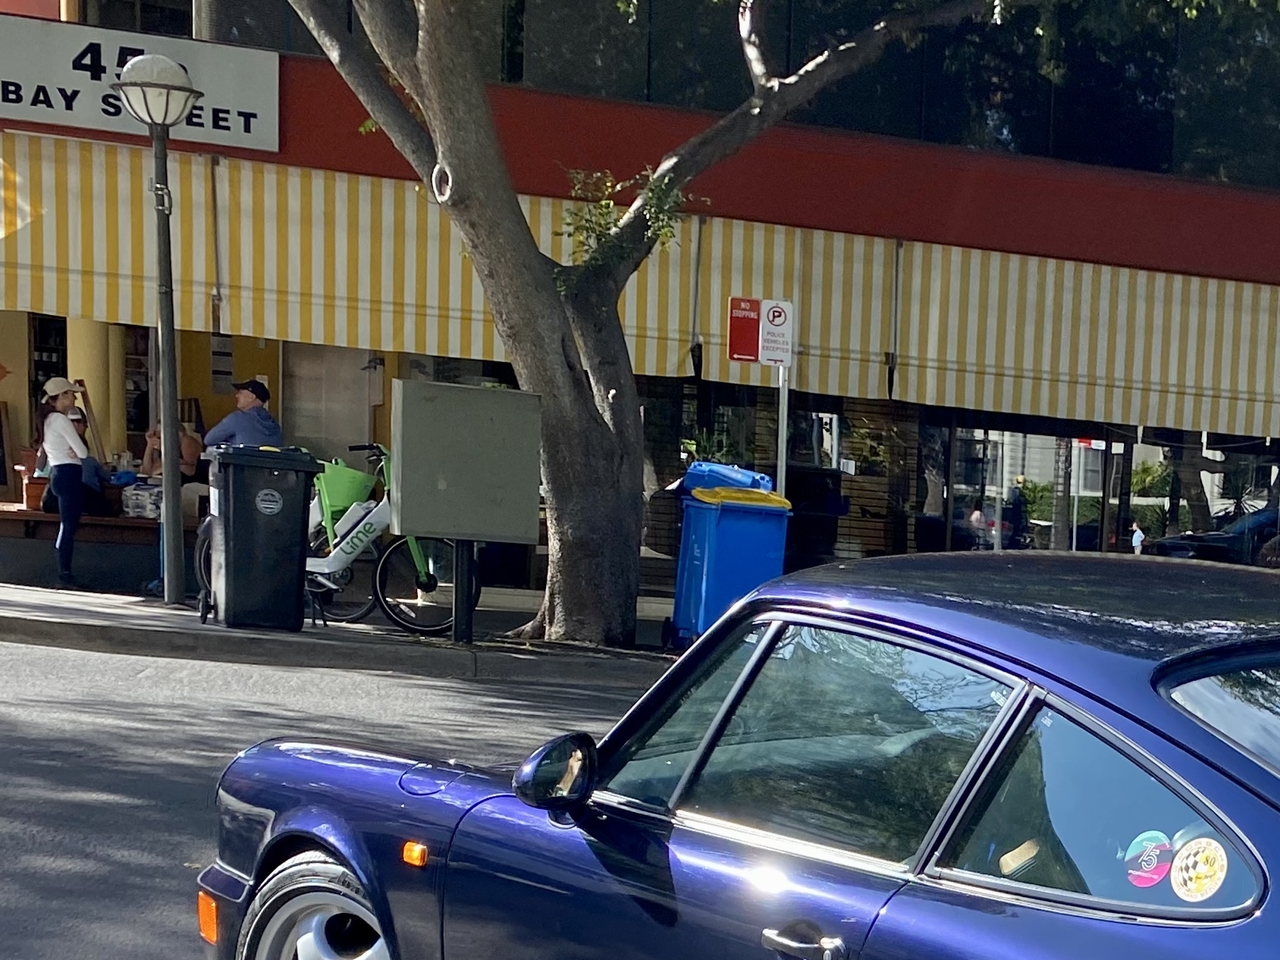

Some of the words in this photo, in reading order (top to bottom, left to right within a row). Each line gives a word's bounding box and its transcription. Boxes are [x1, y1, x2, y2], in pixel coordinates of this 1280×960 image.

[0, 80, 81, 111] BAY
[101, 94, 258, 134] SEET
[732, 309, 758, 319] STOPPING
[740, 302, 751, 310] NO
[340, 521, 376, 555] Lime
